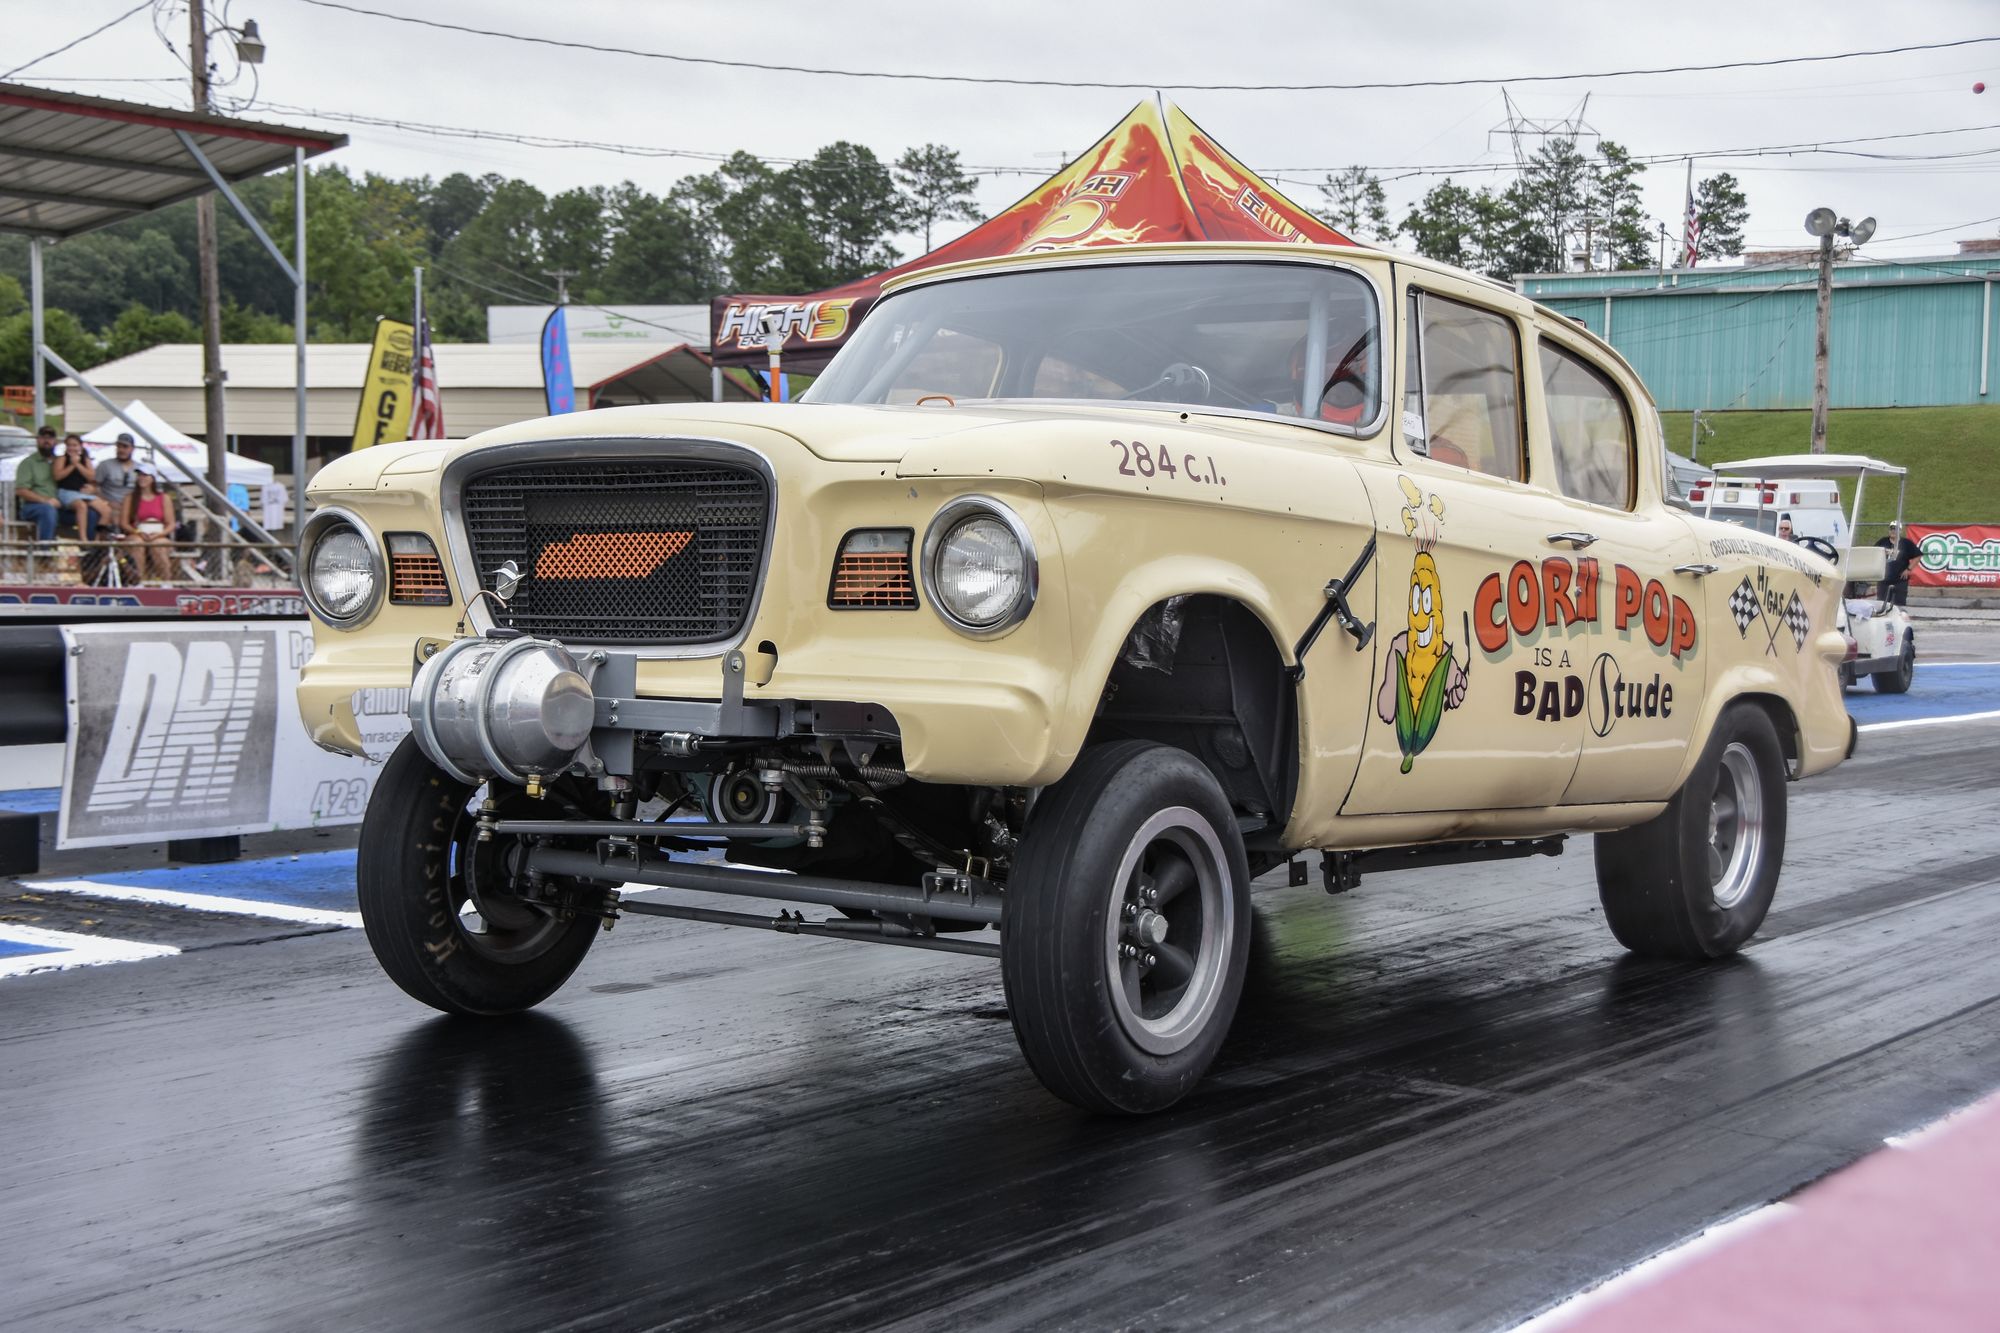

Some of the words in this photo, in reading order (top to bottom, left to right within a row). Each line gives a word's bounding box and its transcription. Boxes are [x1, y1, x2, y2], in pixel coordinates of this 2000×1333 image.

[1110, 439, 1177, 480] 284
[1709, 538, 1750, 558] CROSSVILLE
[1748, 540, 1794, 567] AUTOMOTIVE
[1946, 574, 1968, 582] AUTO
[1969, 575, 1997, 583] PARTS
[1614, 563, 1697, 661] POP
[1534, 648, 1552, 666] IS
[1558, 650, 1571, 668] A
[1513, 670, 1584, 722] BAD
[1587, 652, 1673, 738] Stude
[86, 640, 265, 812] DRI
